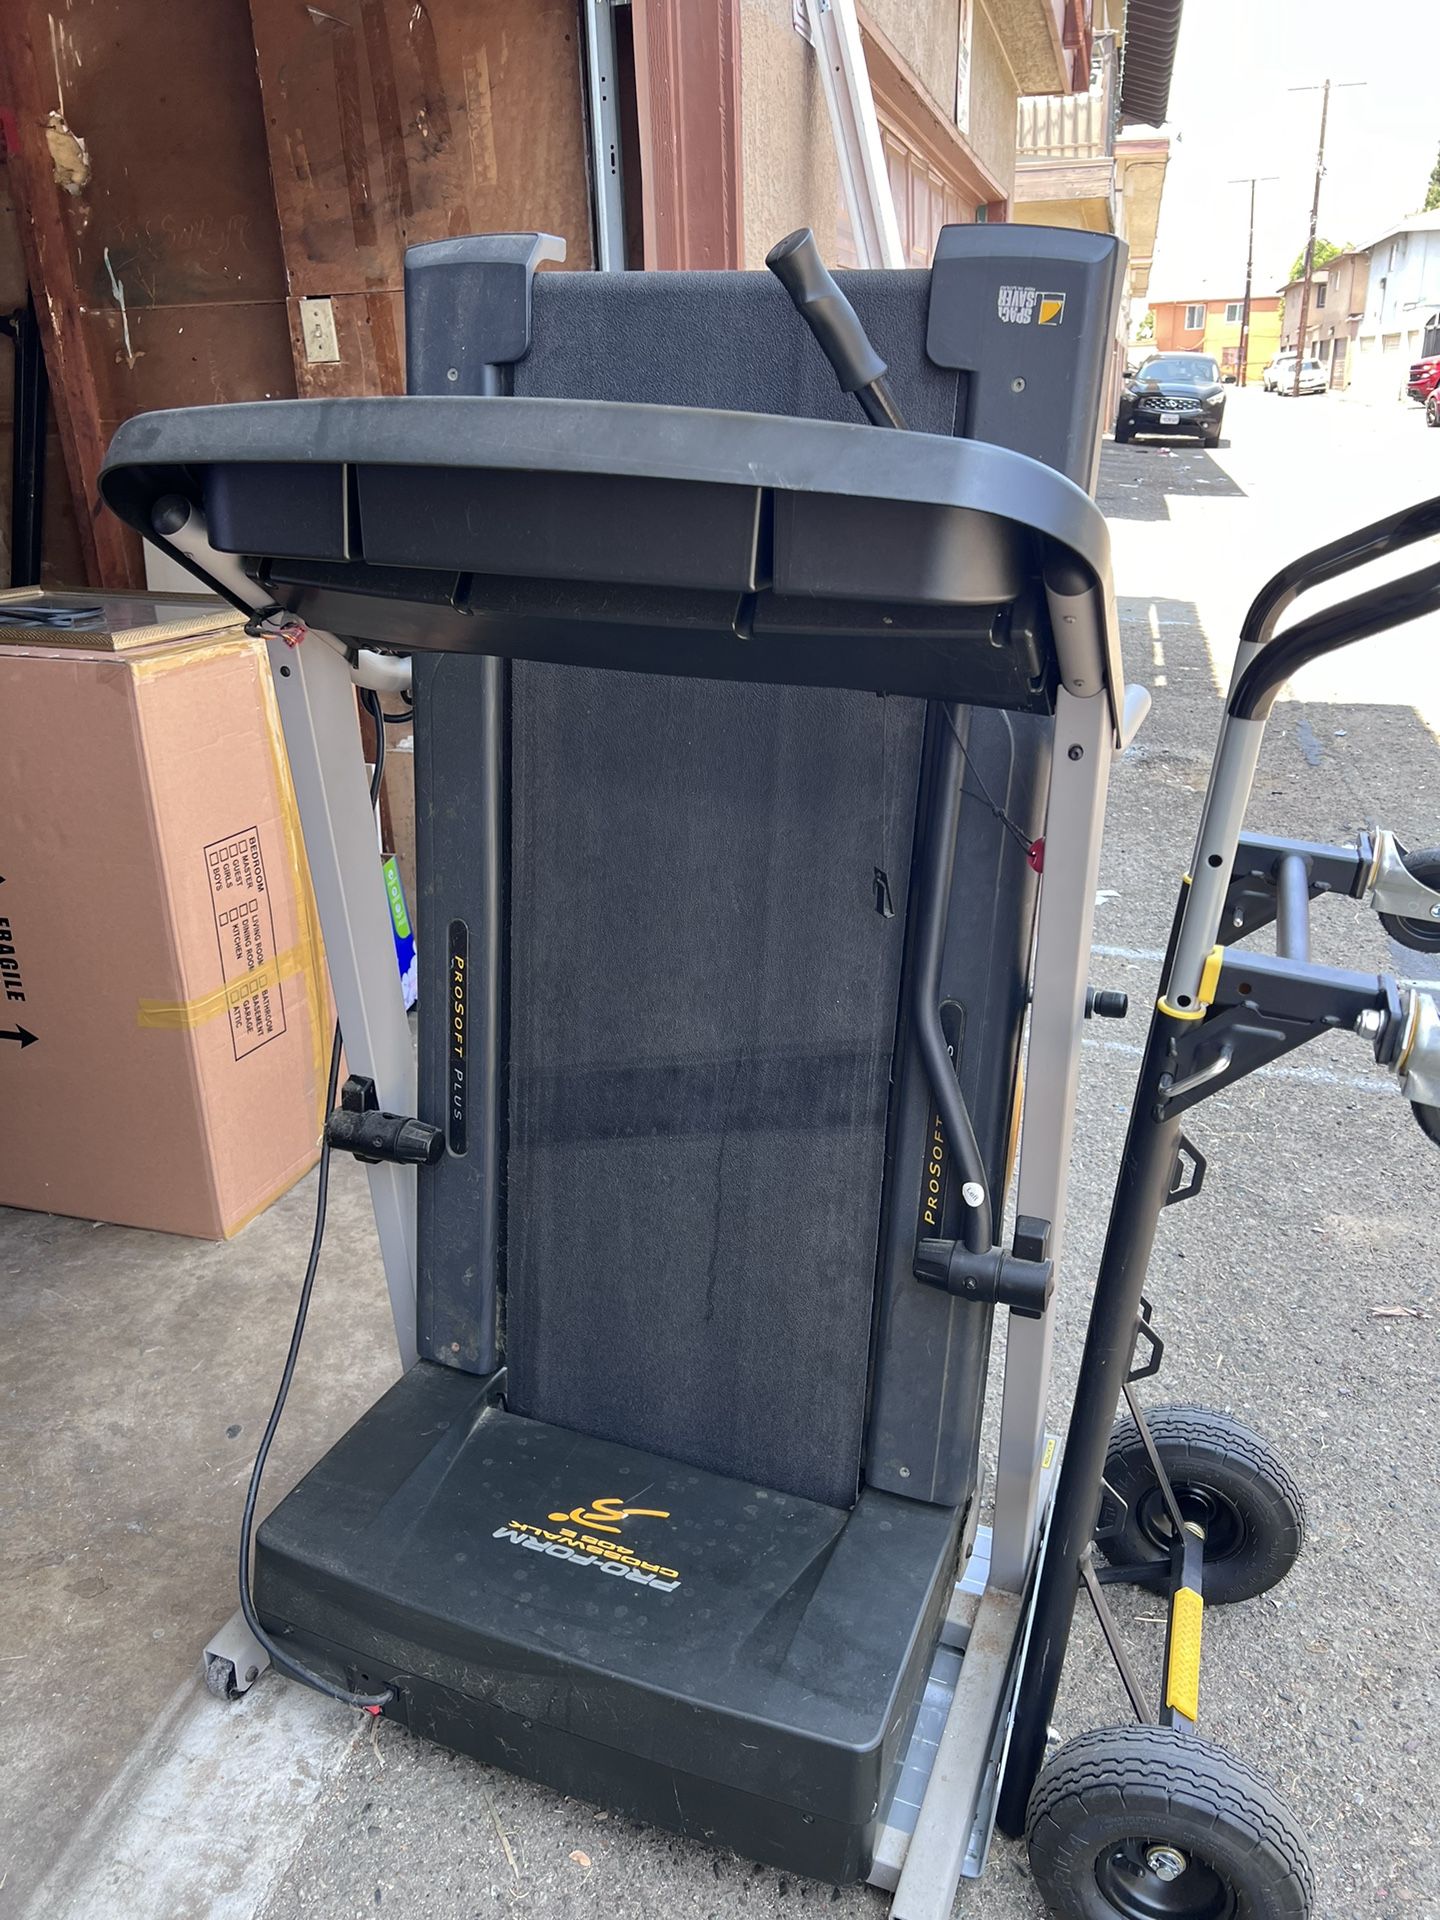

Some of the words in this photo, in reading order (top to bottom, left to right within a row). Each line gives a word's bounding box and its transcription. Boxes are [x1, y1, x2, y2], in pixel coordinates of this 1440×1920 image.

[998, 290, 1035, 307] SAVER
[213, 867, 223, 891] BOYS
[222, 863, 233, 888] GIRLS
[232, 859, 243, 886] GUEST
[242, 854, 254, 889] MASTER
[249, 836, 265, 892] BEDROOM
[232, 923, 243, 960] KITCHEN
[242, 919, 251, 947] DINING
[252, 914, 261, 941] LIVING
[255, 942, 264, 966] ROOM
[233, 1006, 243, 1028] ATTIC
[243, 1000, 254, 1034] GARAGE
[252, 994, 264, 1036] BASEMENT
[261, 989, 273, 1033] BATHROOM
[453, 955, 465, 1058] PROSOFT
[453, 1067, 463, 1121] PLUS
[924, 1114, 944, 1225] PROSOFT
[508, 1519, 680, 1578] CROSSWALK
[559, 1527, 578, 1539] E
[580, 1534, 635, 1555] 405
[492, 1526, 682, 1593] PRO-FORM
